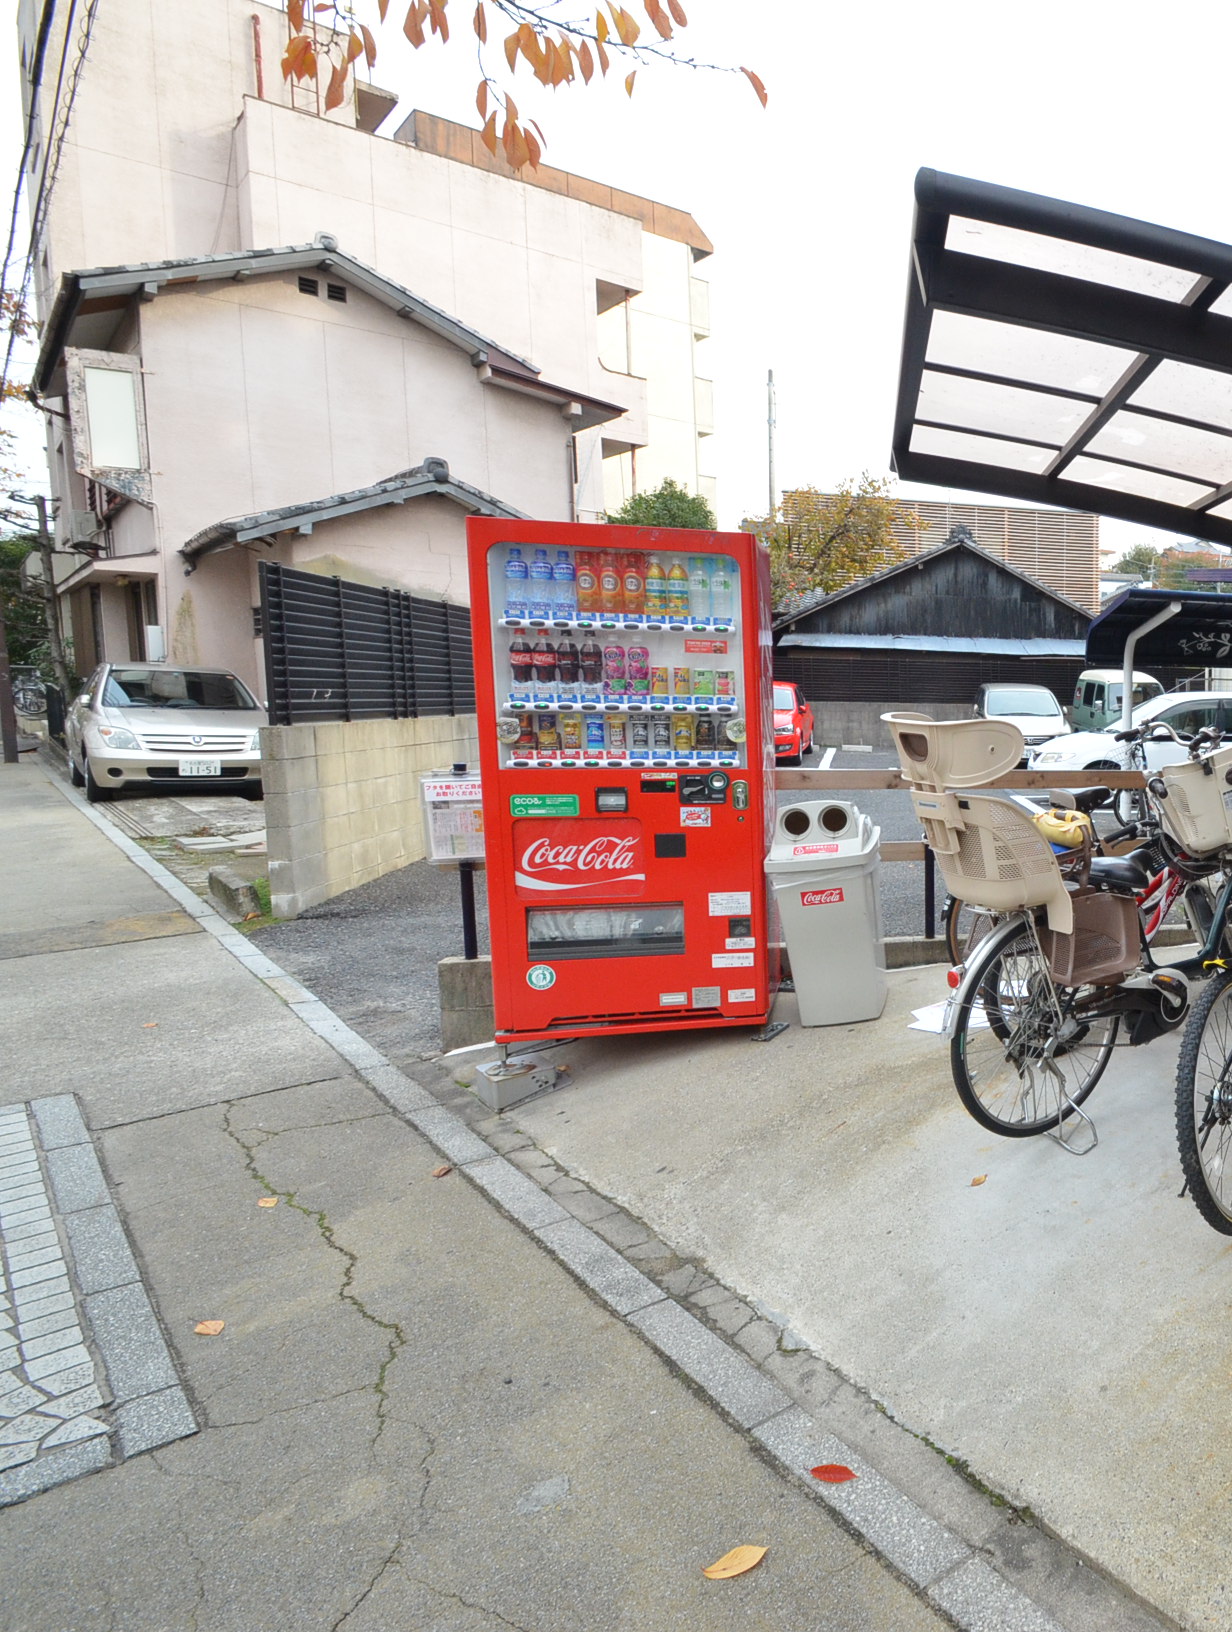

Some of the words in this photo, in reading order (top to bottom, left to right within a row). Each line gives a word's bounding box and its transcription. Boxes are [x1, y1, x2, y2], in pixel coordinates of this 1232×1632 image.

[190, 766, 217, 774] 11-51
[521, 836, 640, 872] Coca-Cola
[803, 890, 841, 905] Coca-Cola
